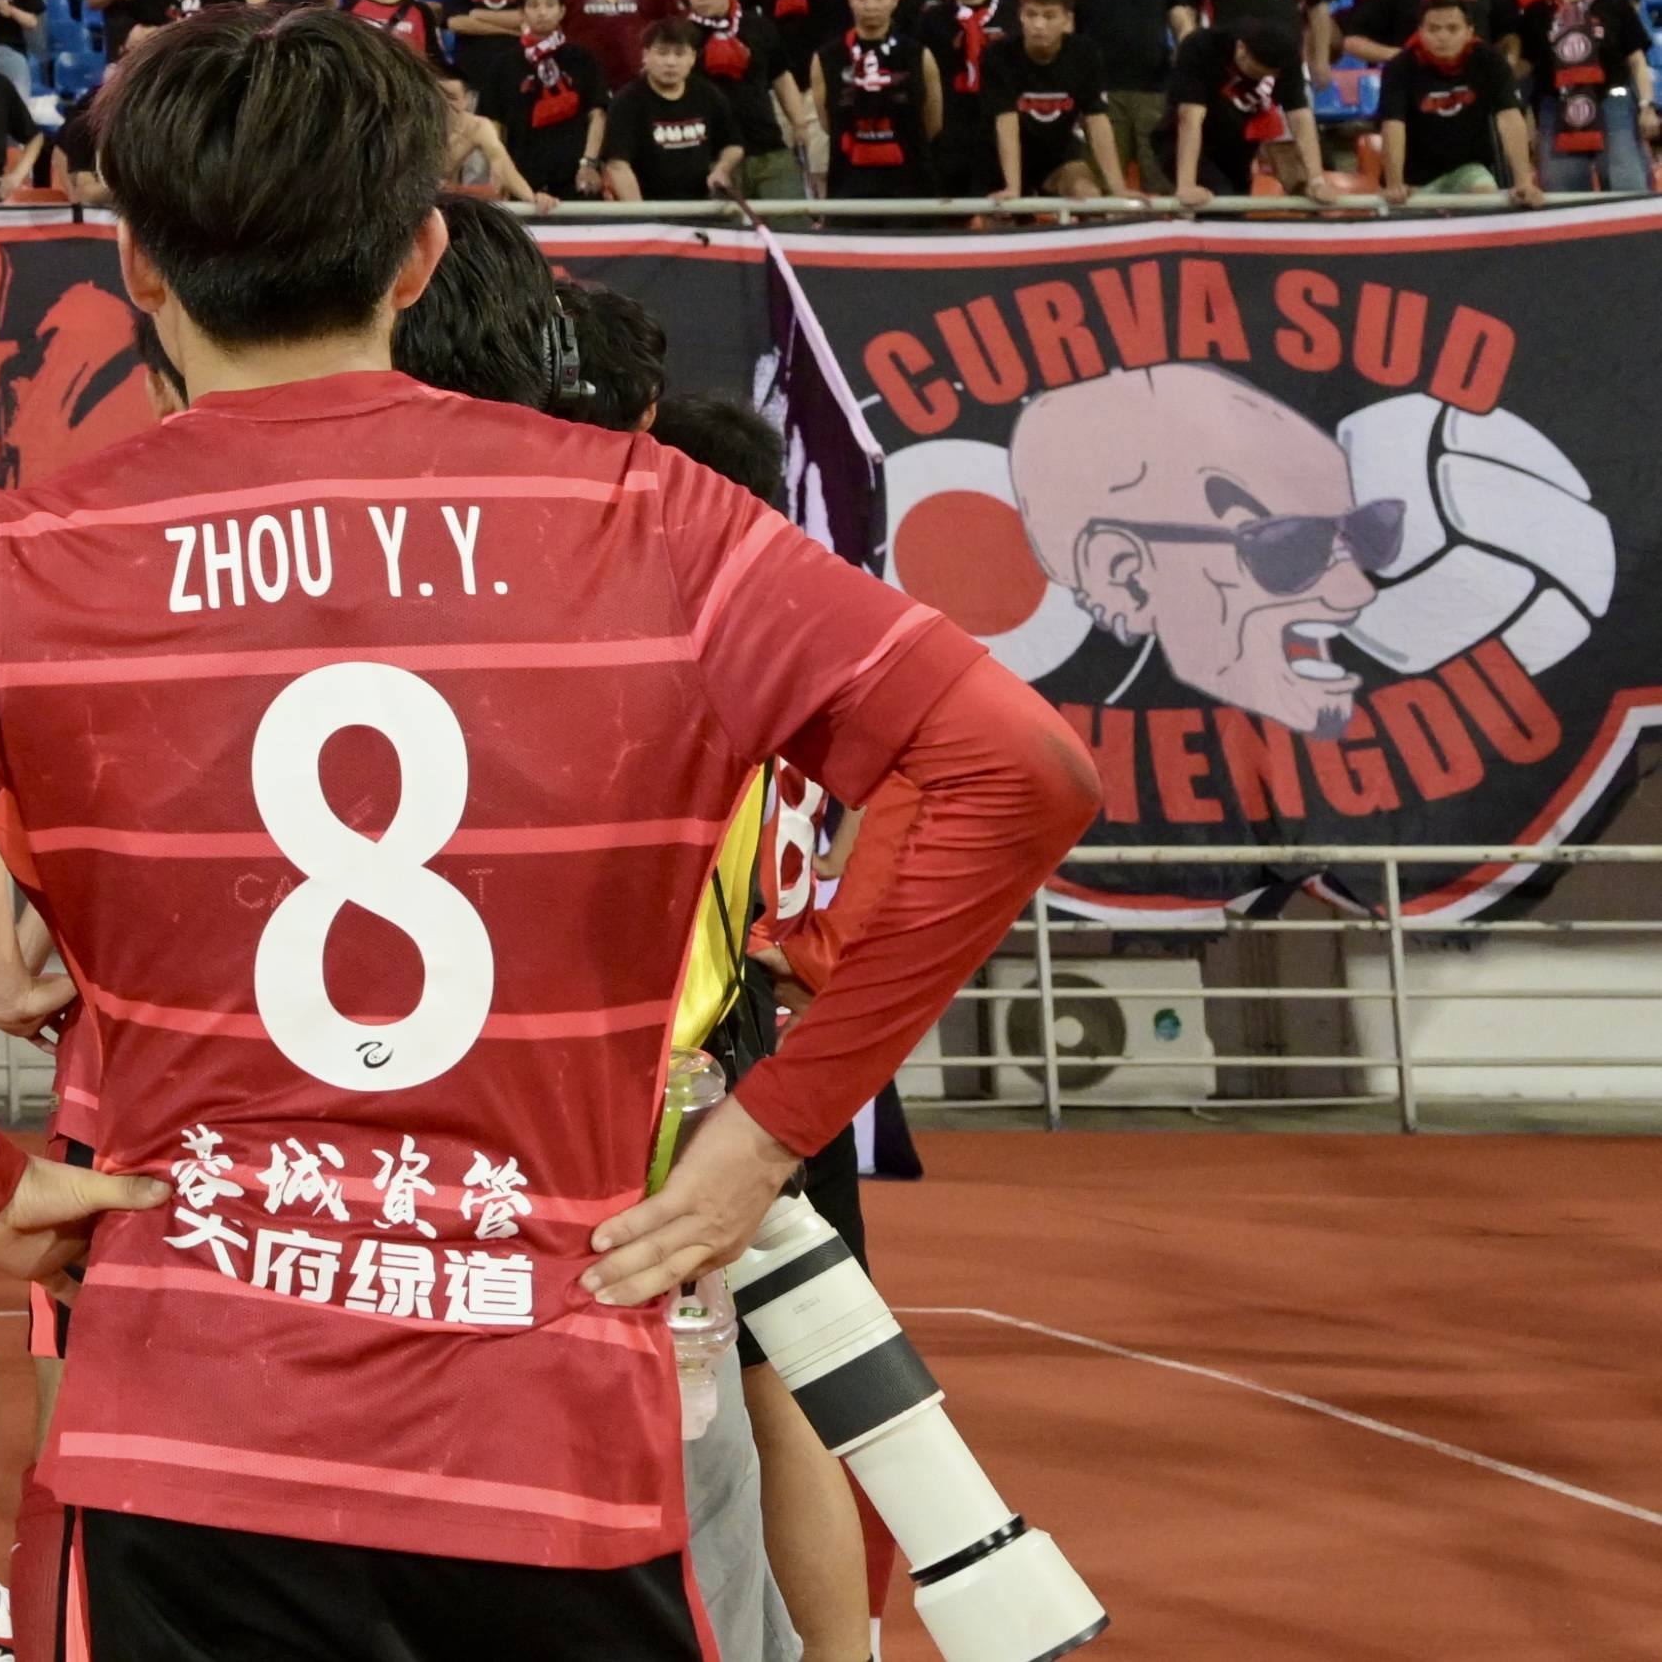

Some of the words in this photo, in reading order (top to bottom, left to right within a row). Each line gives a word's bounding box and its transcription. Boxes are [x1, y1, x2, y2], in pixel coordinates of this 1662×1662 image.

[864, 259, 1251, 436] CURVA
[1274, 269, 1516, 416] SUD
[164, 506, 333, 613] ZHOU
[367, 505, 508, 597] Y.Y.
[1062, 638, 1562, 824] HENGDU
[251, 661, 494, 1092] 8
[163, 1205, 534, 1326] 天府绿道
